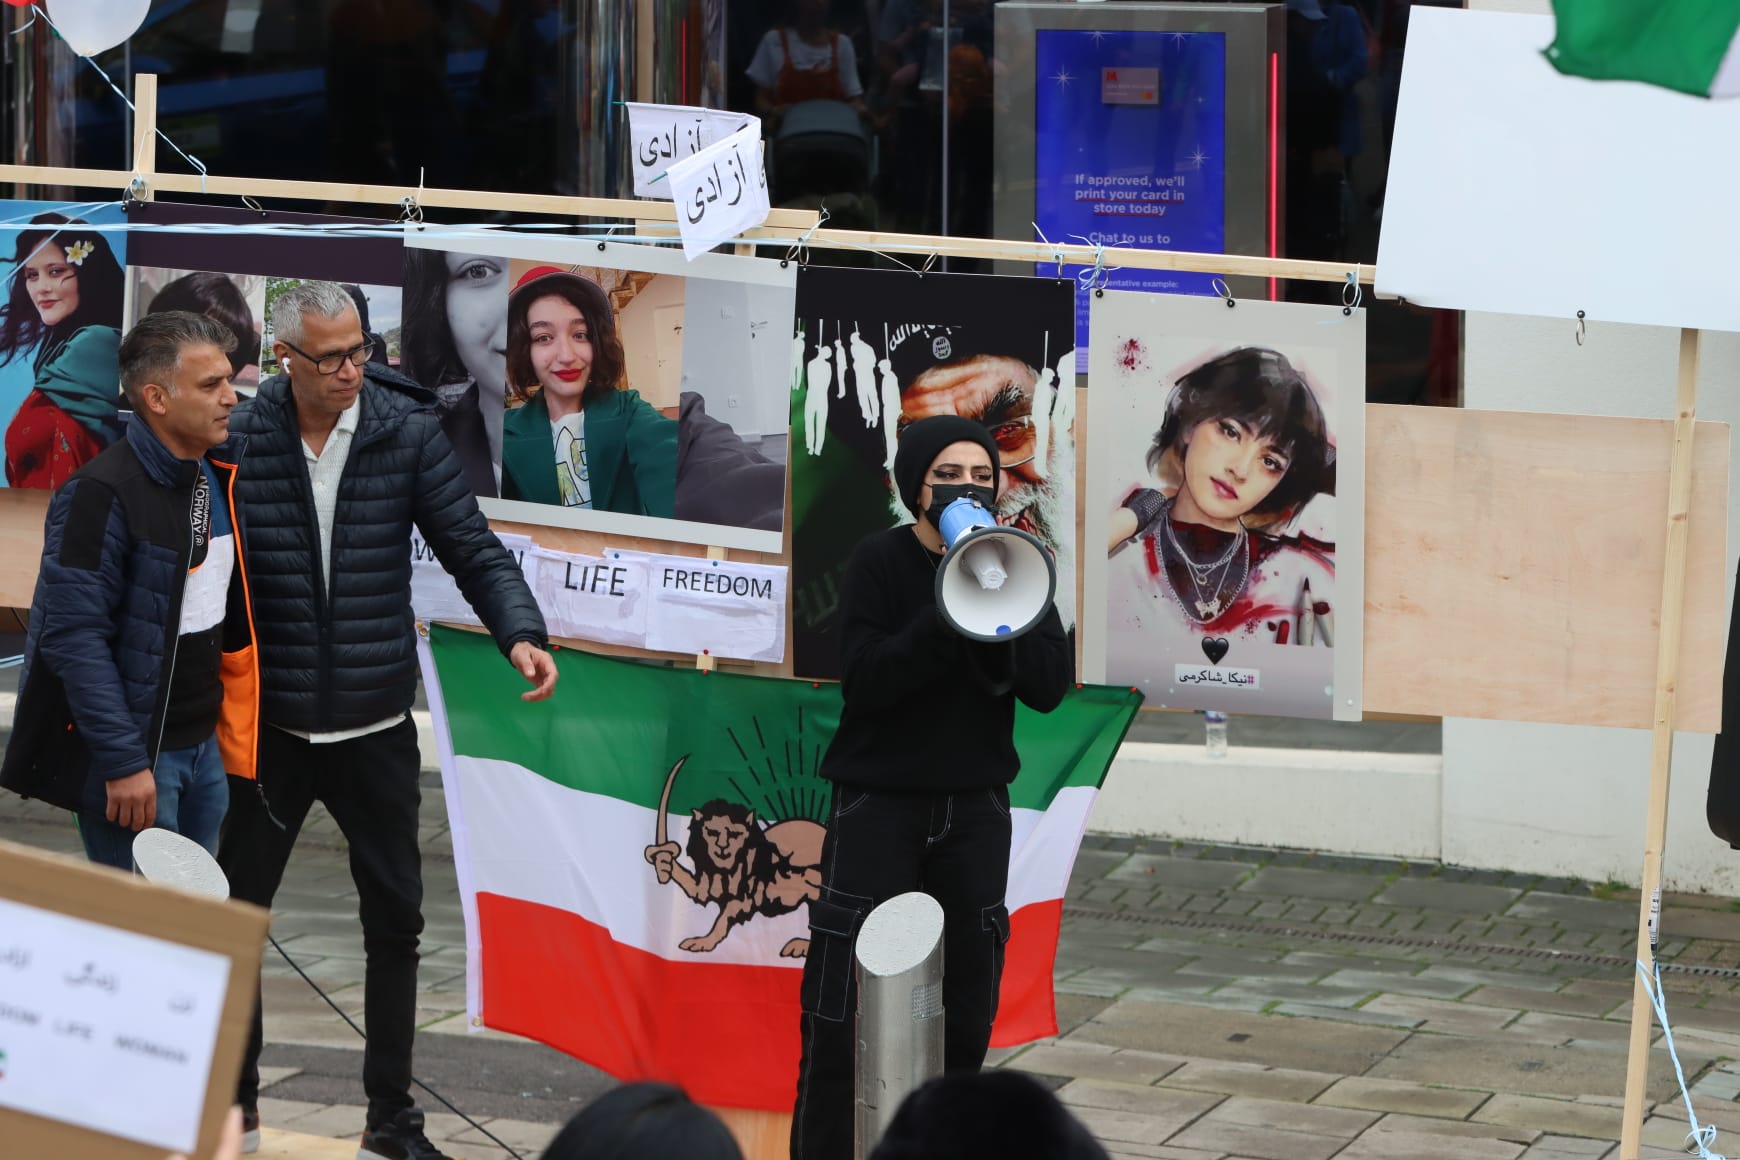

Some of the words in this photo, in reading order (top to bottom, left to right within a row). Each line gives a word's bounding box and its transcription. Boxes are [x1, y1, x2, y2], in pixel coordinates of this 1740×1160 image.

[1075, 174, 1084, 185] If
[1088, 176, 1152, 187] approved,
[1156, 175, 1185, 186] we'll
[1075, 189, 1105, 201] print
[1109, 191, 1137, 201] your
[1141, 190, 1169, 201] card
[1173, 190, 1185, 201] in
[1094, 203, 1126, 213] store
[1130, 203, 1166, 216] today
[1089, 232, 1118, 243] Chat
[1122, 234, 1136, 243] to
[1139, 235, 1153, 244] us
[1157, 234, 1171, 244] to
[564, 561, 627, 597] LIFE
[663, 568, 772, 600] FREEDOM
